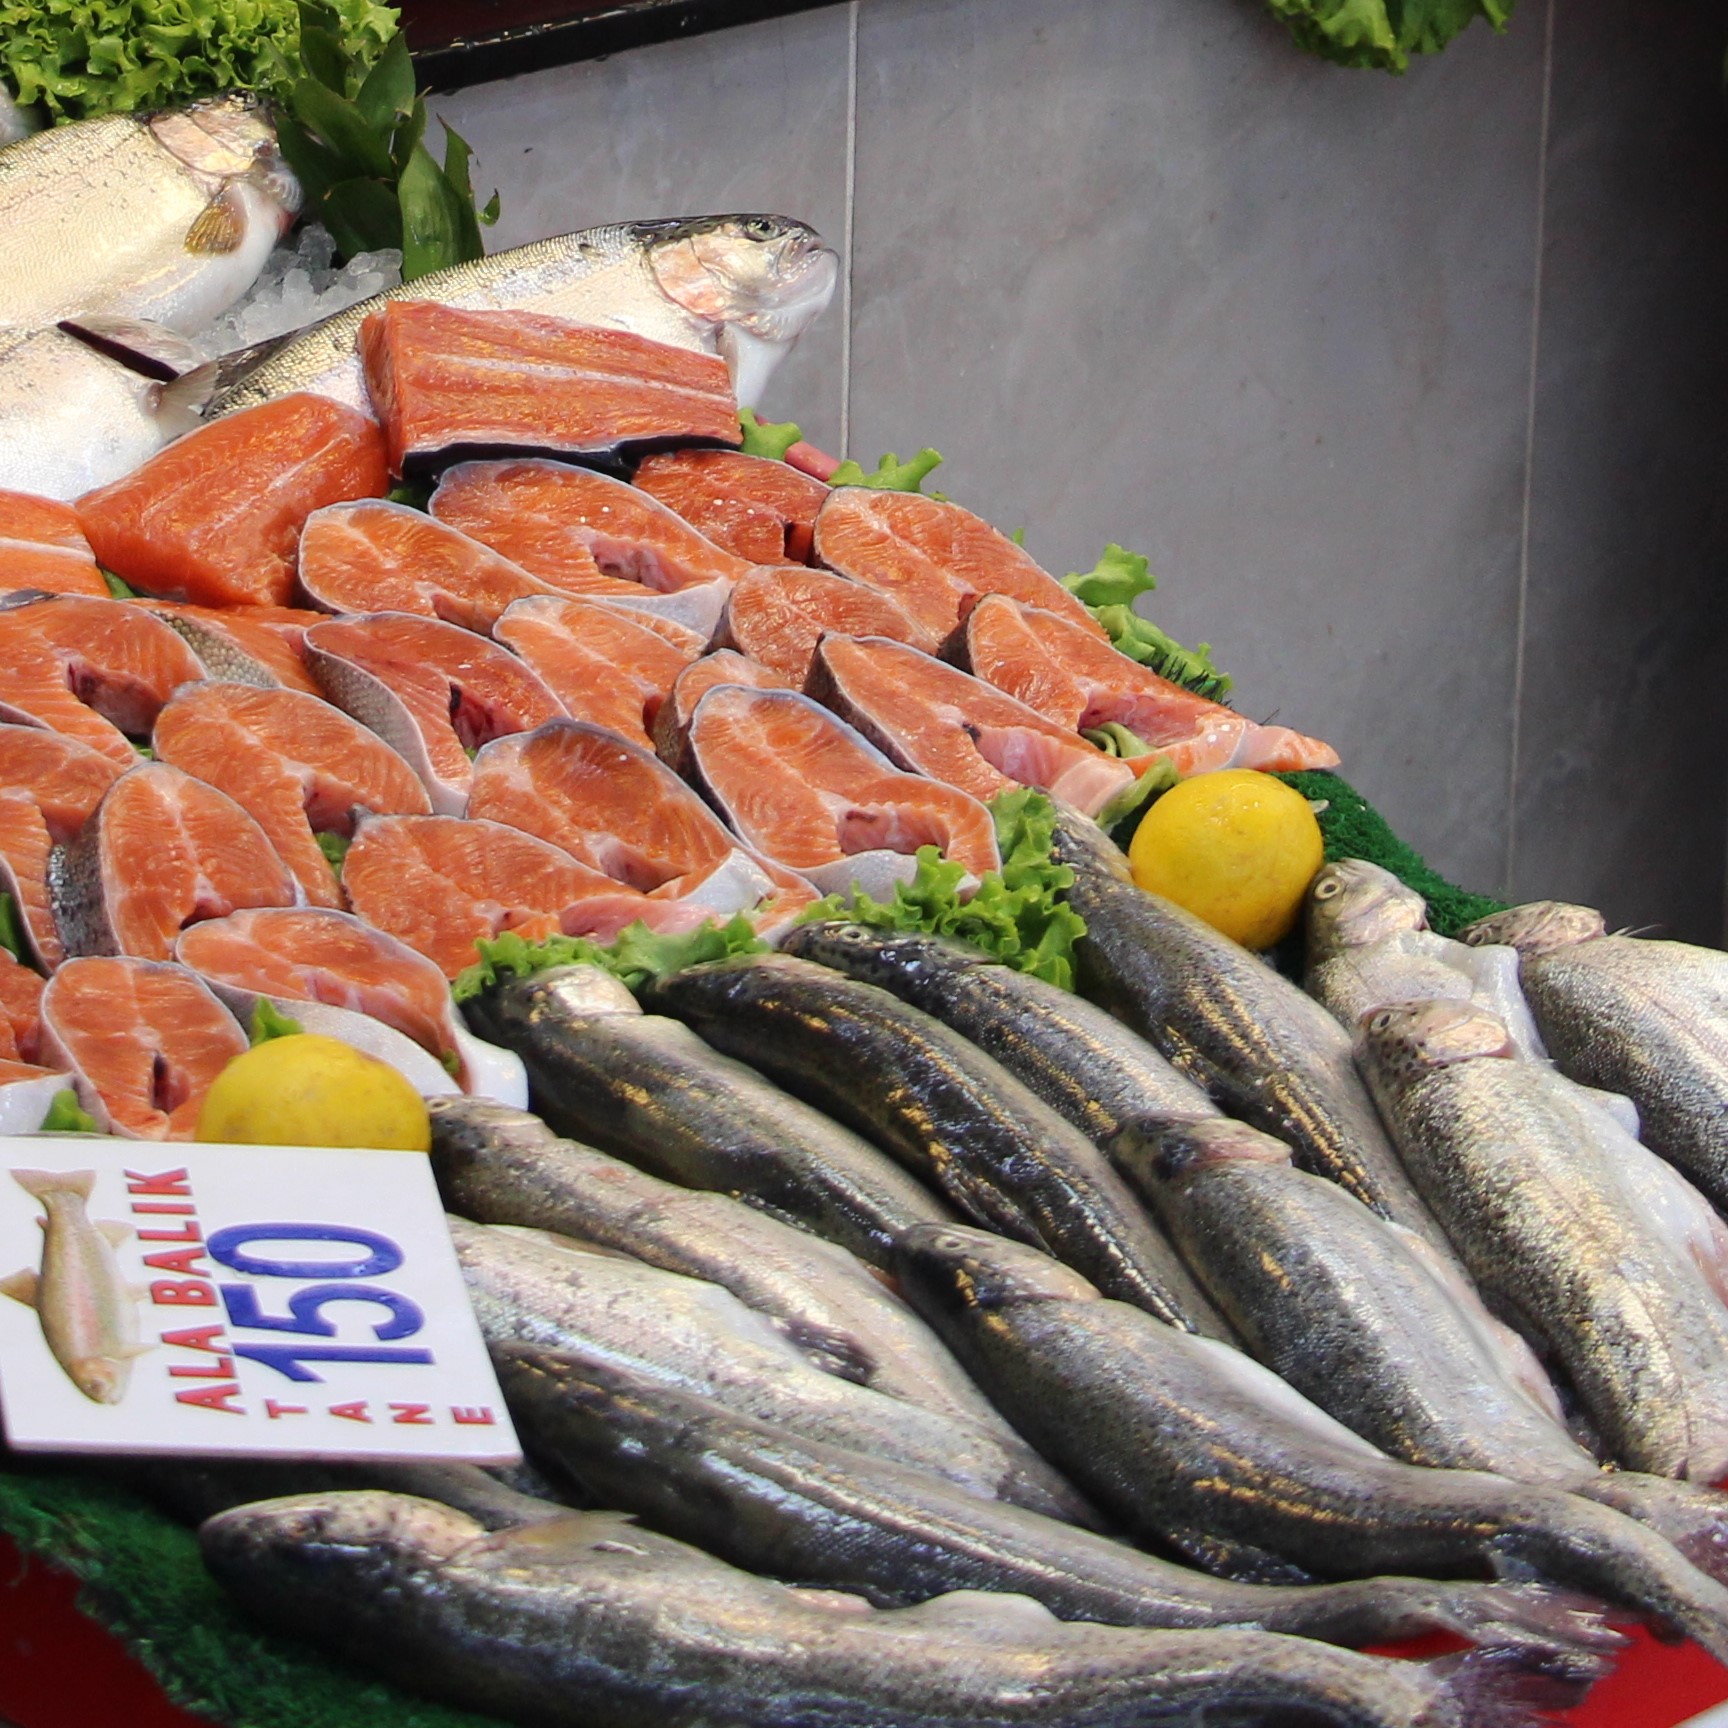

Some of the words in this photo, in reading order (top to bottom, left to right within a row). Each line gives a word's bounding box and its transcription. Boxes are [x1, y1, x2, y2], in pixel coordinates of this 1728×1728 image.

[123, 1168, 222, 1307] BALIK
[205, 1222, 437, 1384] 150
[161, 1324, 248, 1414] ALA
[264, 1399, 498, 1425] TANE
